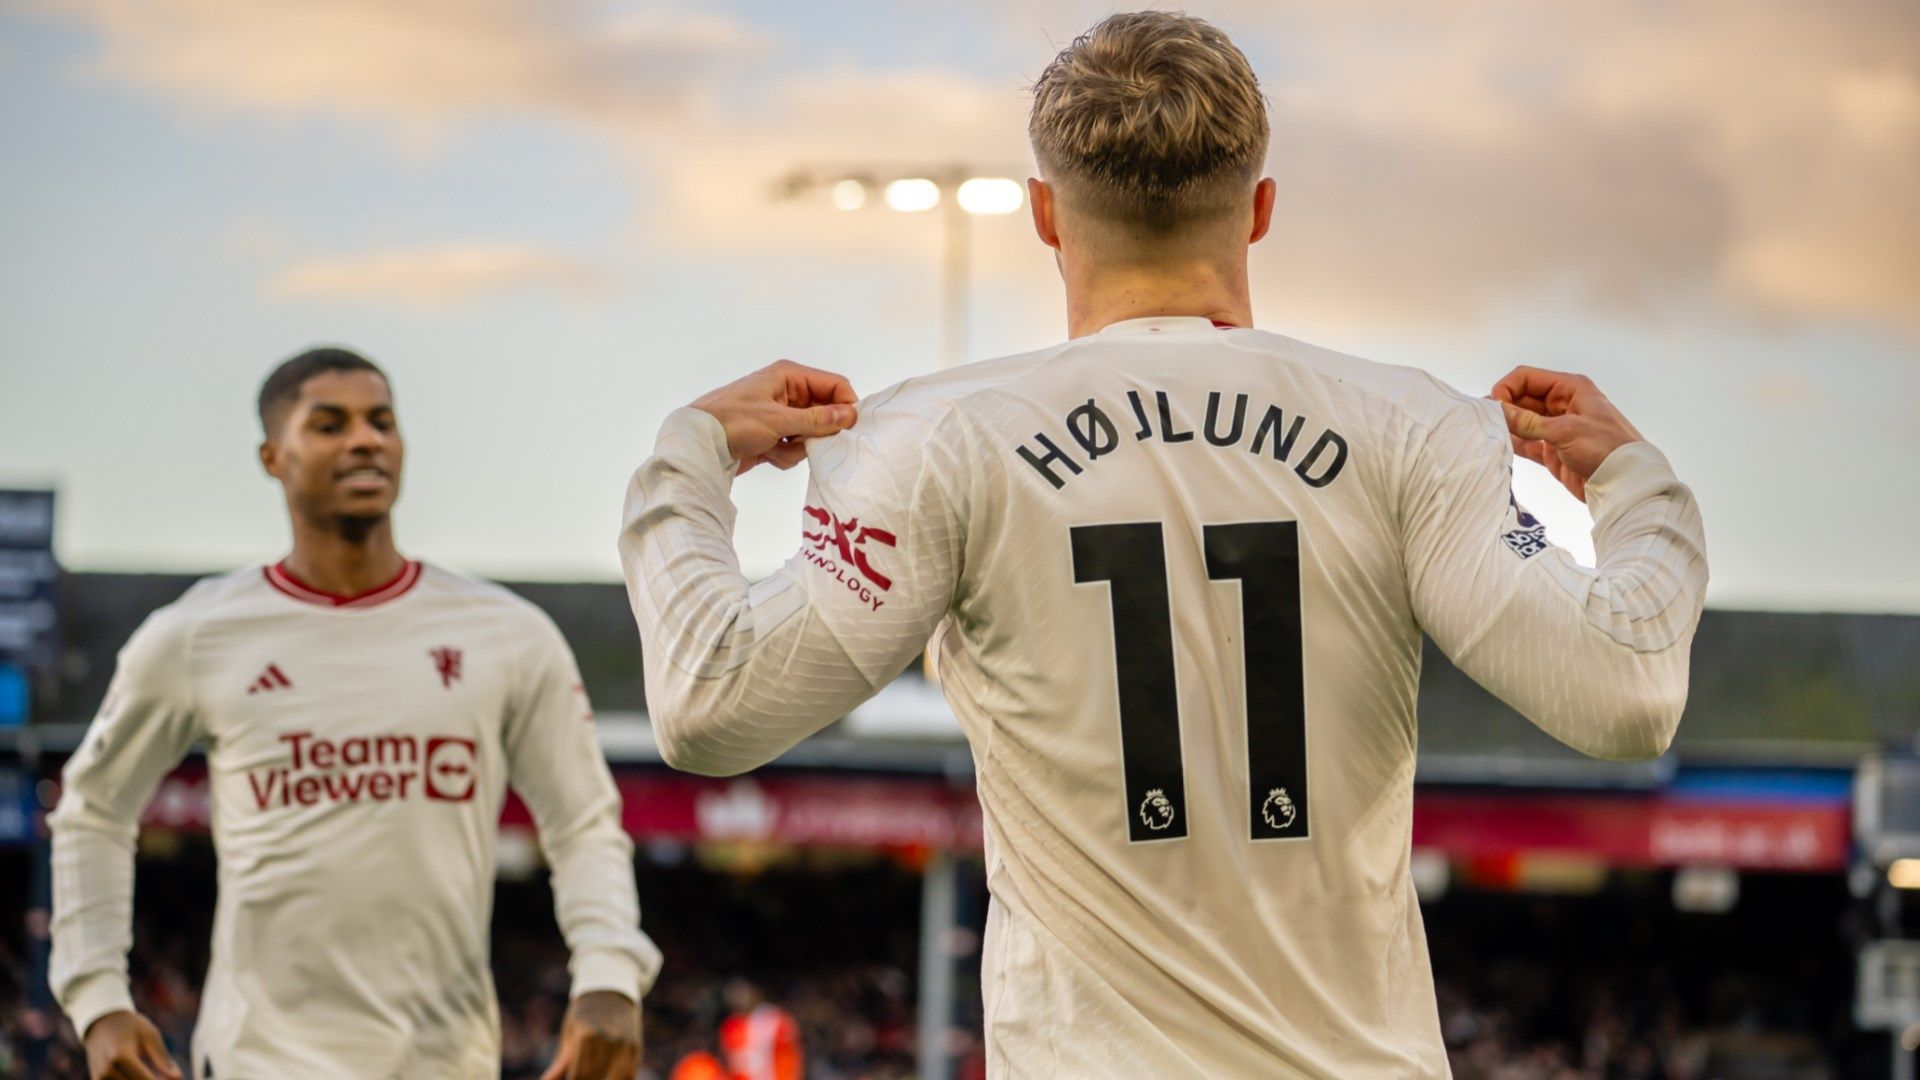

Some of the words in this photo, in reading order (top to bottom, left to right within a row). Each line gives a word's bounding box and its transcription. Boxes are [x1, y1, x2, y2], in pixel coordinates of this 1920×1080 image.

[1015, 390, 1349, 490] HØJLUND
[800, 548, 884, 612] HNOLOGY
[1069, 520, 1311, 843] 11
[278, 731, 418, 771] Team
[248, 769, 418, 812] Viewer
